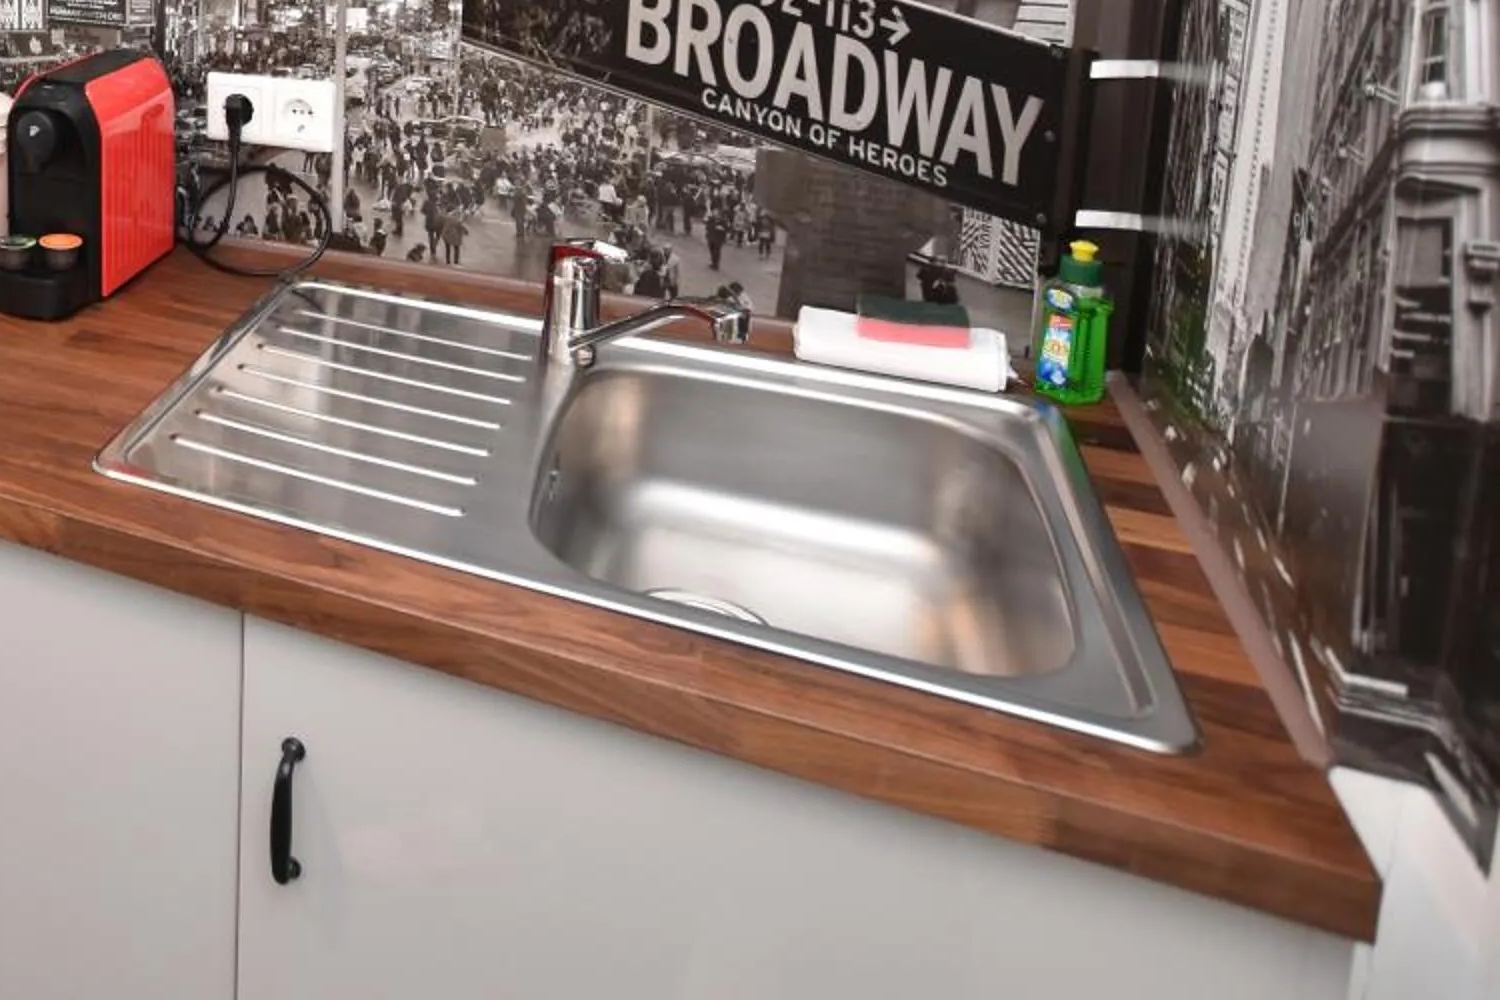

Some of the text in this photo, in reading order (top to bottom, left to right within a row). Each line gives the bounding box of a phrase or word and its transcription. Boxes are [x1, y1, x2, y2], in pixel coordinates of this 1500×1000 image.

[703, 88, 949, 187] CANYON OF HEROES
